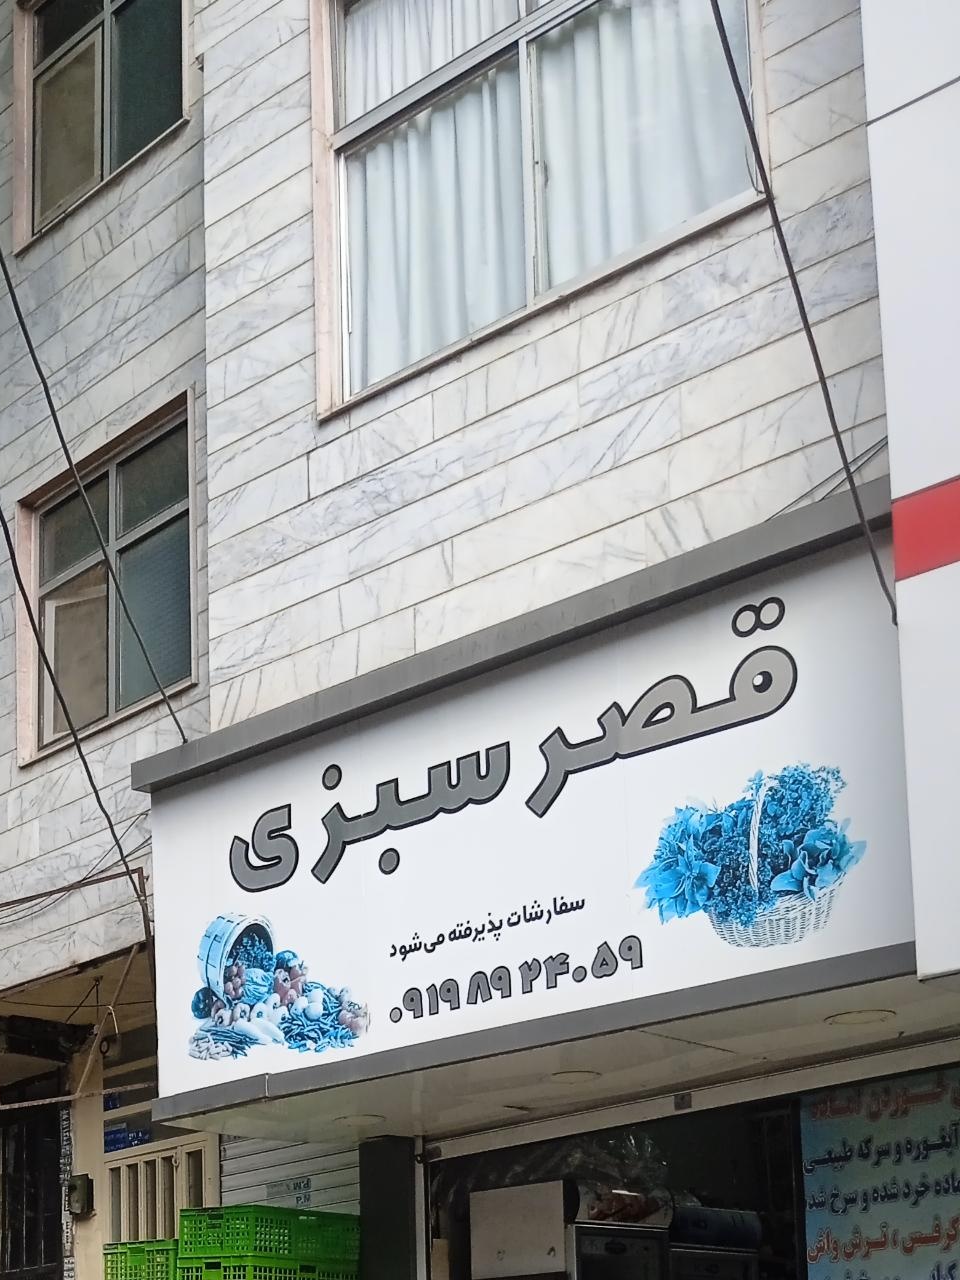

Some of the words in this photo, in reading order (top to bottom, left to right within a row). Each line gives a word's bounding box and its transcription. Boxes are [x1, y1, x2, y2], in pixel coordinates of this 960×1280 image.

[526, 596, 798, 819] قصر
[228, 739, 512, 894] سبزی
[447, 911, 503, 942] پذیرفته
[506, 895, 586, 929] سفارشات
